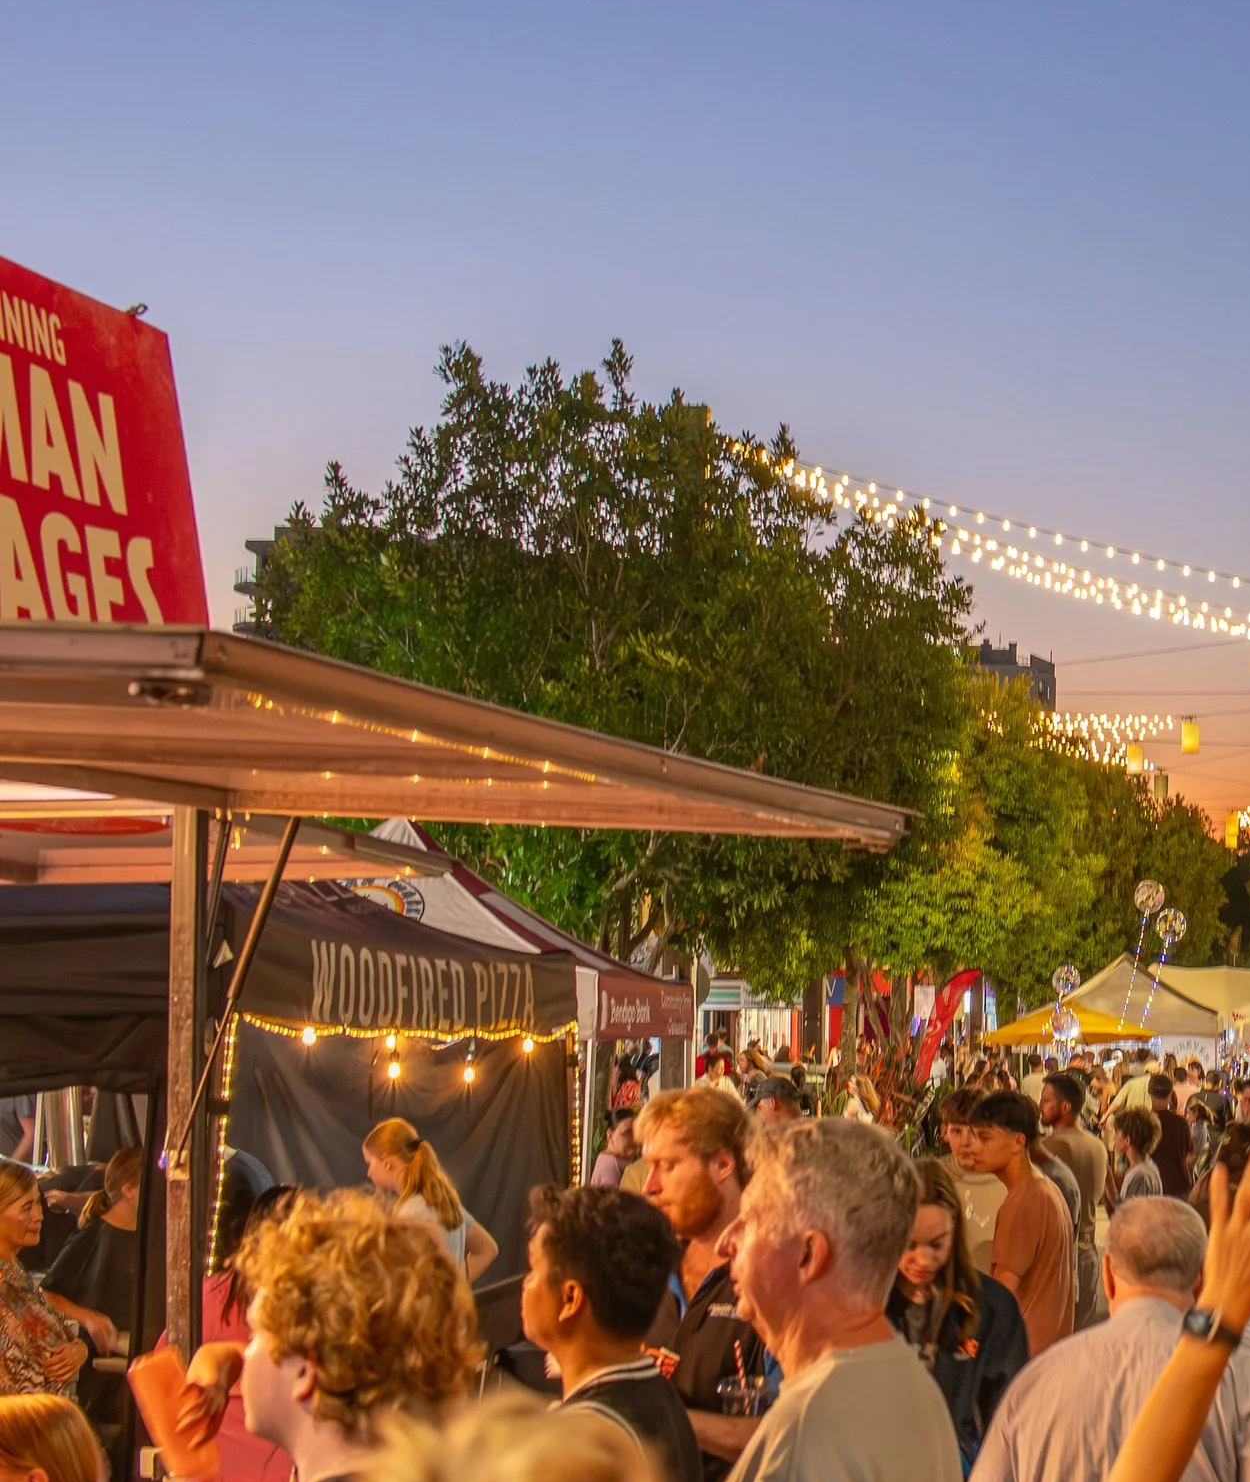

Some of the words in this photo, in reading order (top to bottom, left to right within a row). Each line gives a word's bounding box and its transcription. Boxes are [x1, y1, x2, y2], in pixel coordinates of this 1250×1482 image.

[311, 938, 467, 1033] WOODFIRED
[472, 961, 535, 1031] PIZZA
[610, 996, 636, 1032] Bendigo
[635, 997, 651, 1024] Bank
